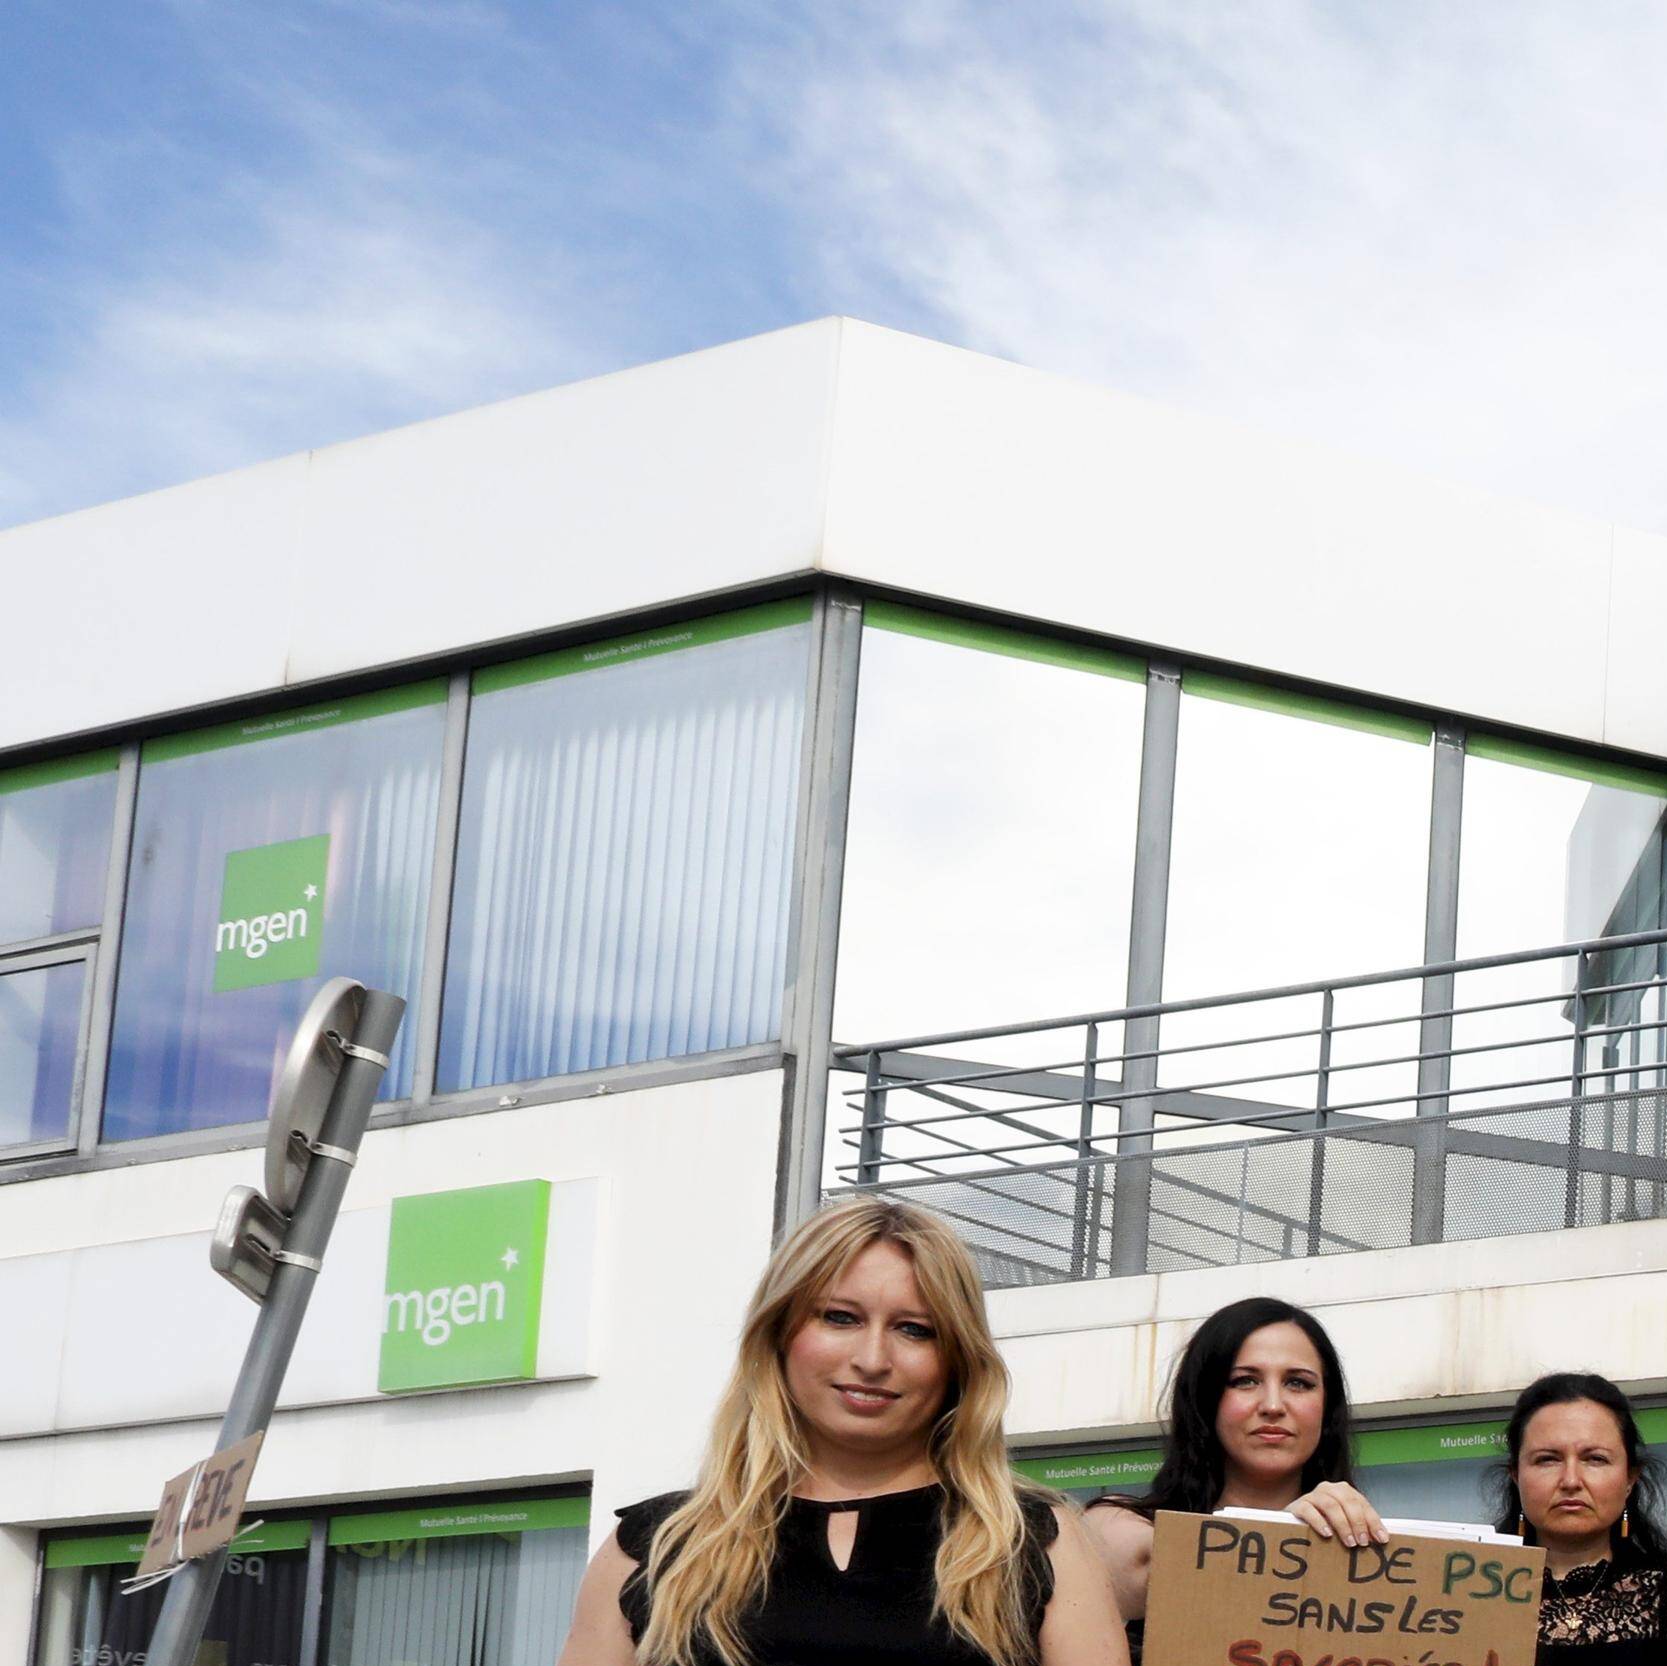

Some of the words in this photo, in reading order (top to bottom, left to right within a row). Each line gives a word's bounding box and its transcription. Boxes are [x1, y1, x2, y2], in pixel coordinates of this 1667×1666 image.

[215, 907, 308, 959] mgen
[381, 1280, 506, 1346] mgen
[1440, 1435, 1487, 1448] Mutuelle
[1046, 1467, 1088, 1479] Mutuelle
[1089, 1465, 1116, 1476] Santé
[1196, 1520, 1312, 1580] PAS
[1349, 1541, 1416, 1584] DE
[1261, 1592, 1394, 1633] SANS
[1398, 1595, 1463, 1634] LES
